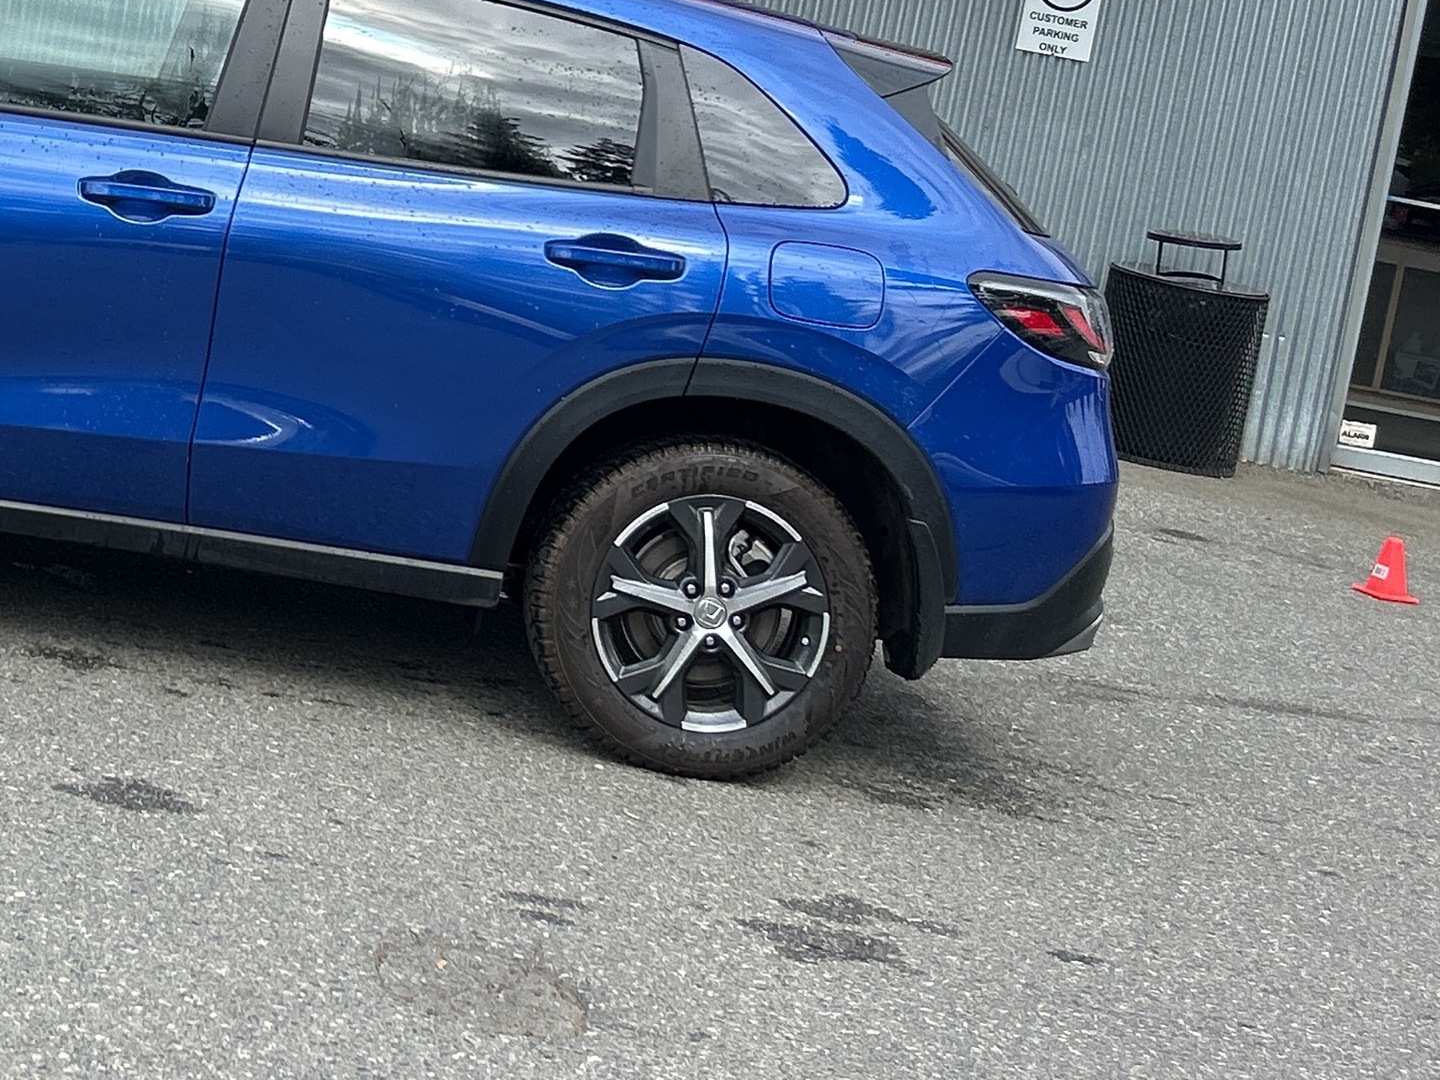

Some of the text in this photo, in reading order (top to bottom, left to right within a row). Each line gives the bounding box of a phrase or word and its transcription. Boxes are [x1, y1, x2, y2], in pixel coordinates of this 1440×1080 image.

[1029, 10, 1089, 29] CUSTOMER
[1032, 26, 1079, 43] PARKING
[1039, 42, 1067, 54] ONLY
